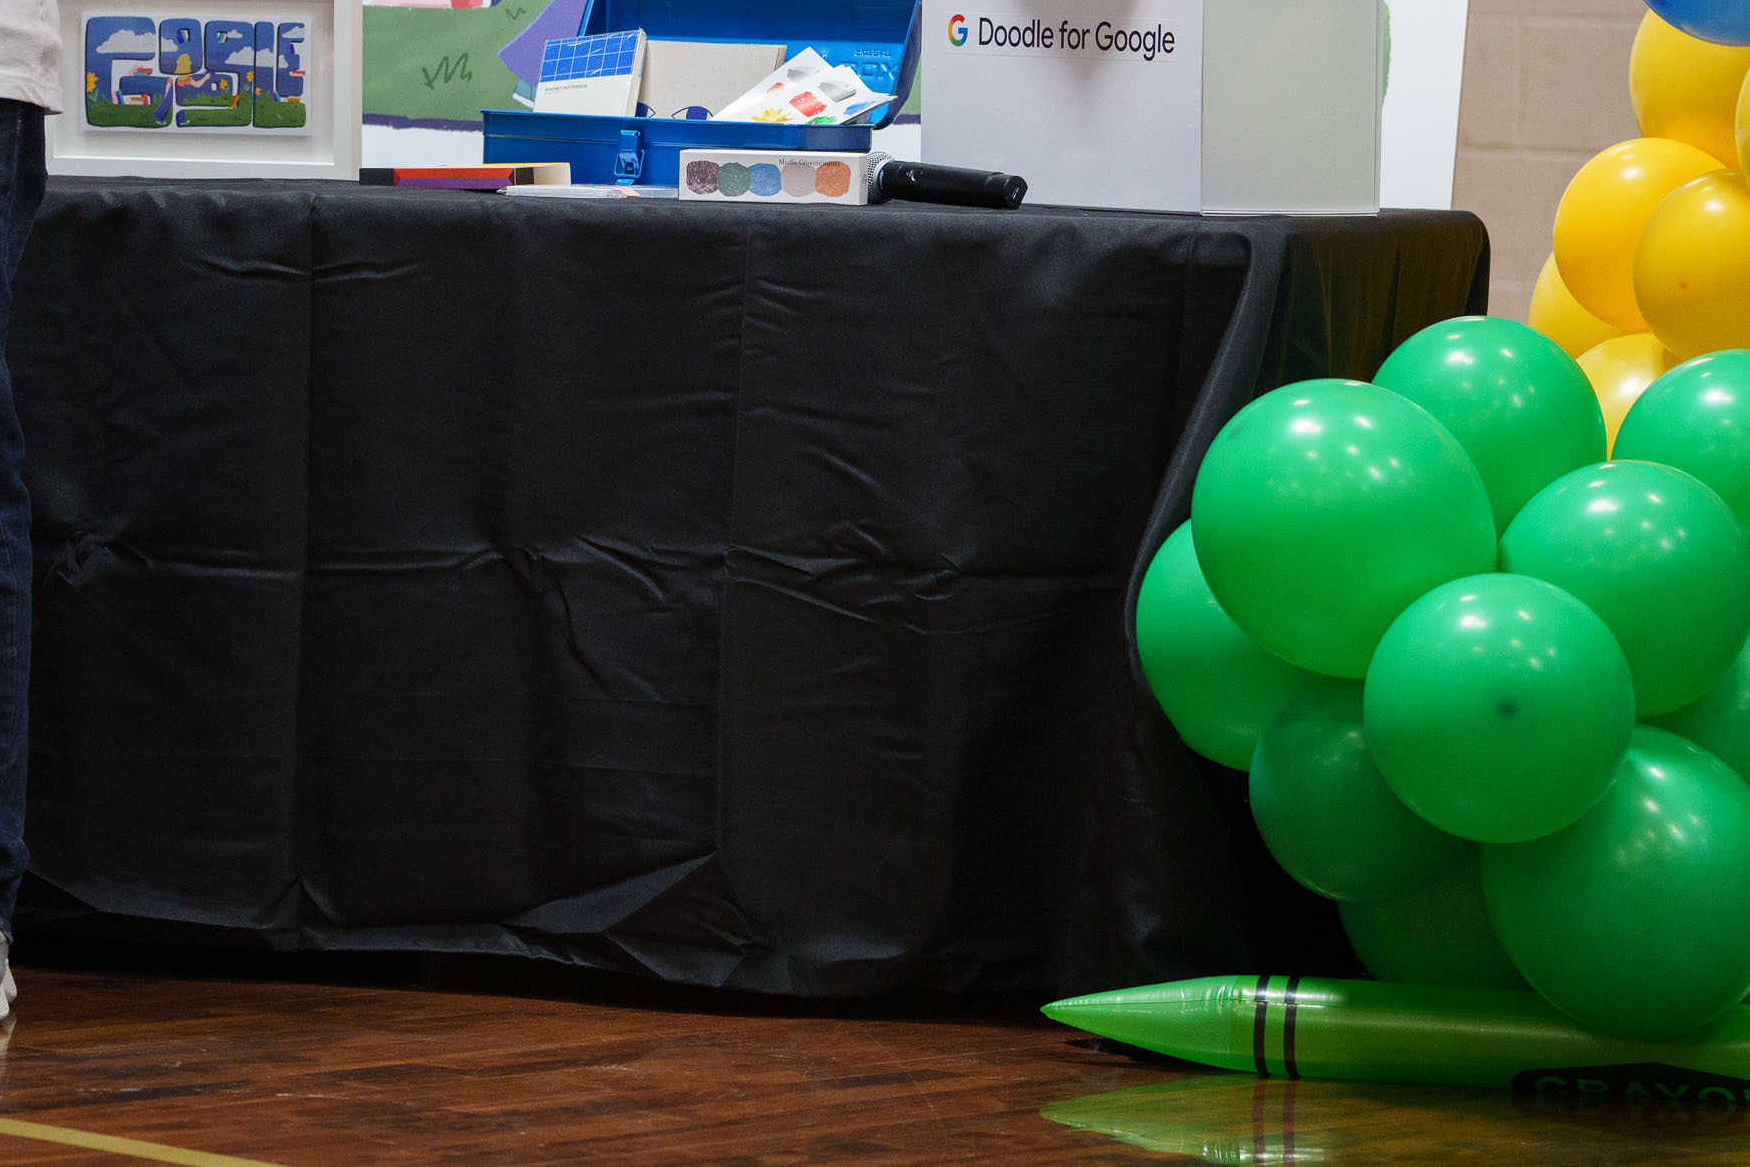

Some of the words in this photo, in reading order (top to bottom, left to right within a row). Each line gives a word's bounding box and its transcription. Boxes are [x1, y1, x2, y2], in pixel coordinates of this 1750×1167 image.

[978, 17, 1054, 48] Doodle
[1058, 20, 1091, 50] for
[1095, 21, 1176, 62] Google
